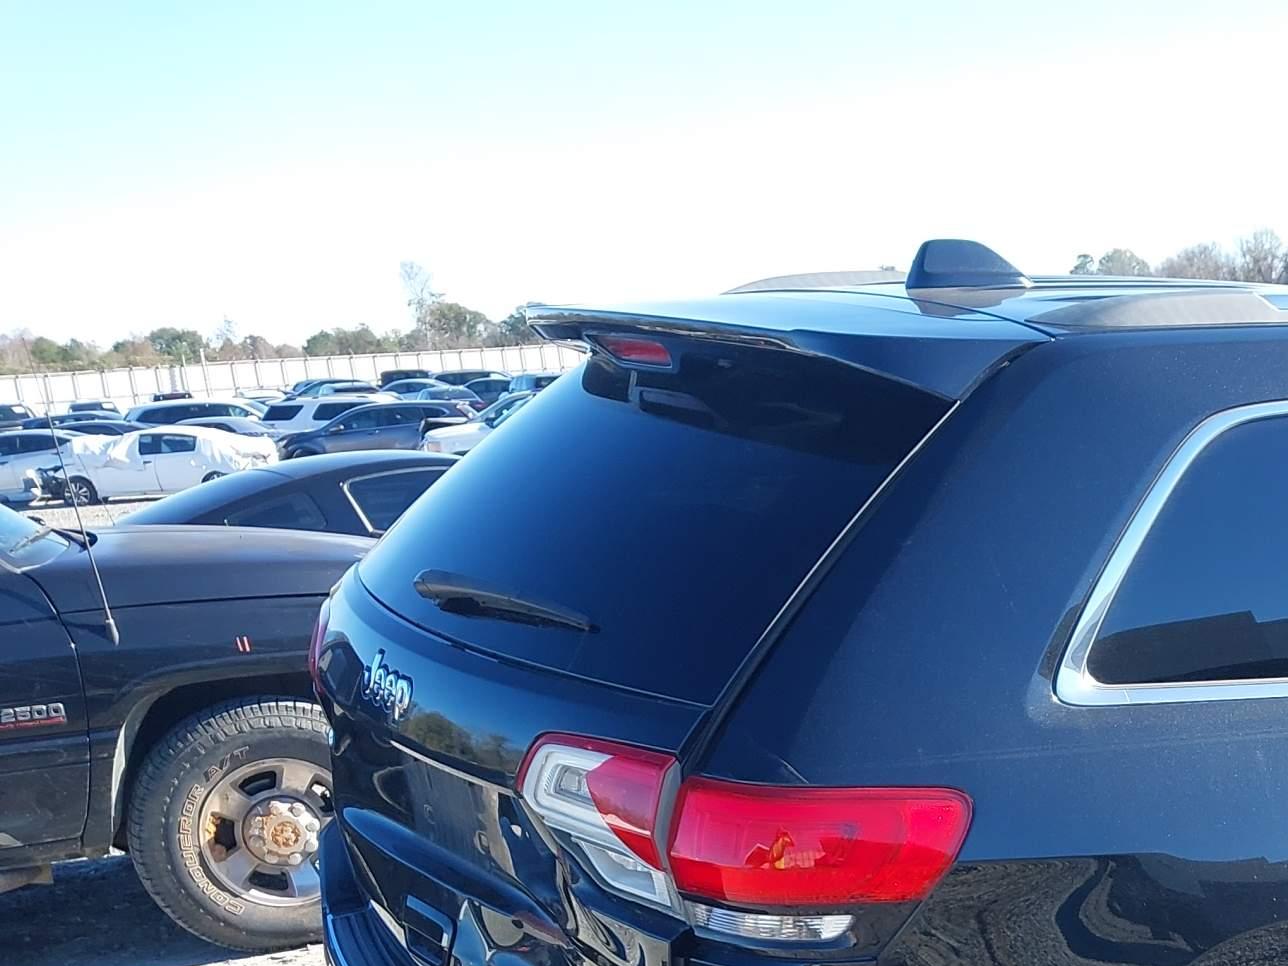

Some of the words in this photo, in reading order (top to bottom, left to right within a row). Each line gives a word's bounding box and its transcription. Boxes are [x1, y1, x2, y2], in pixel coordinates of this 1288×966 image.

[0, 702, 66, 723] 2500
[363, 652, 413, 721] Jeep
[178, 783, 246, 916] CONQUEROR
